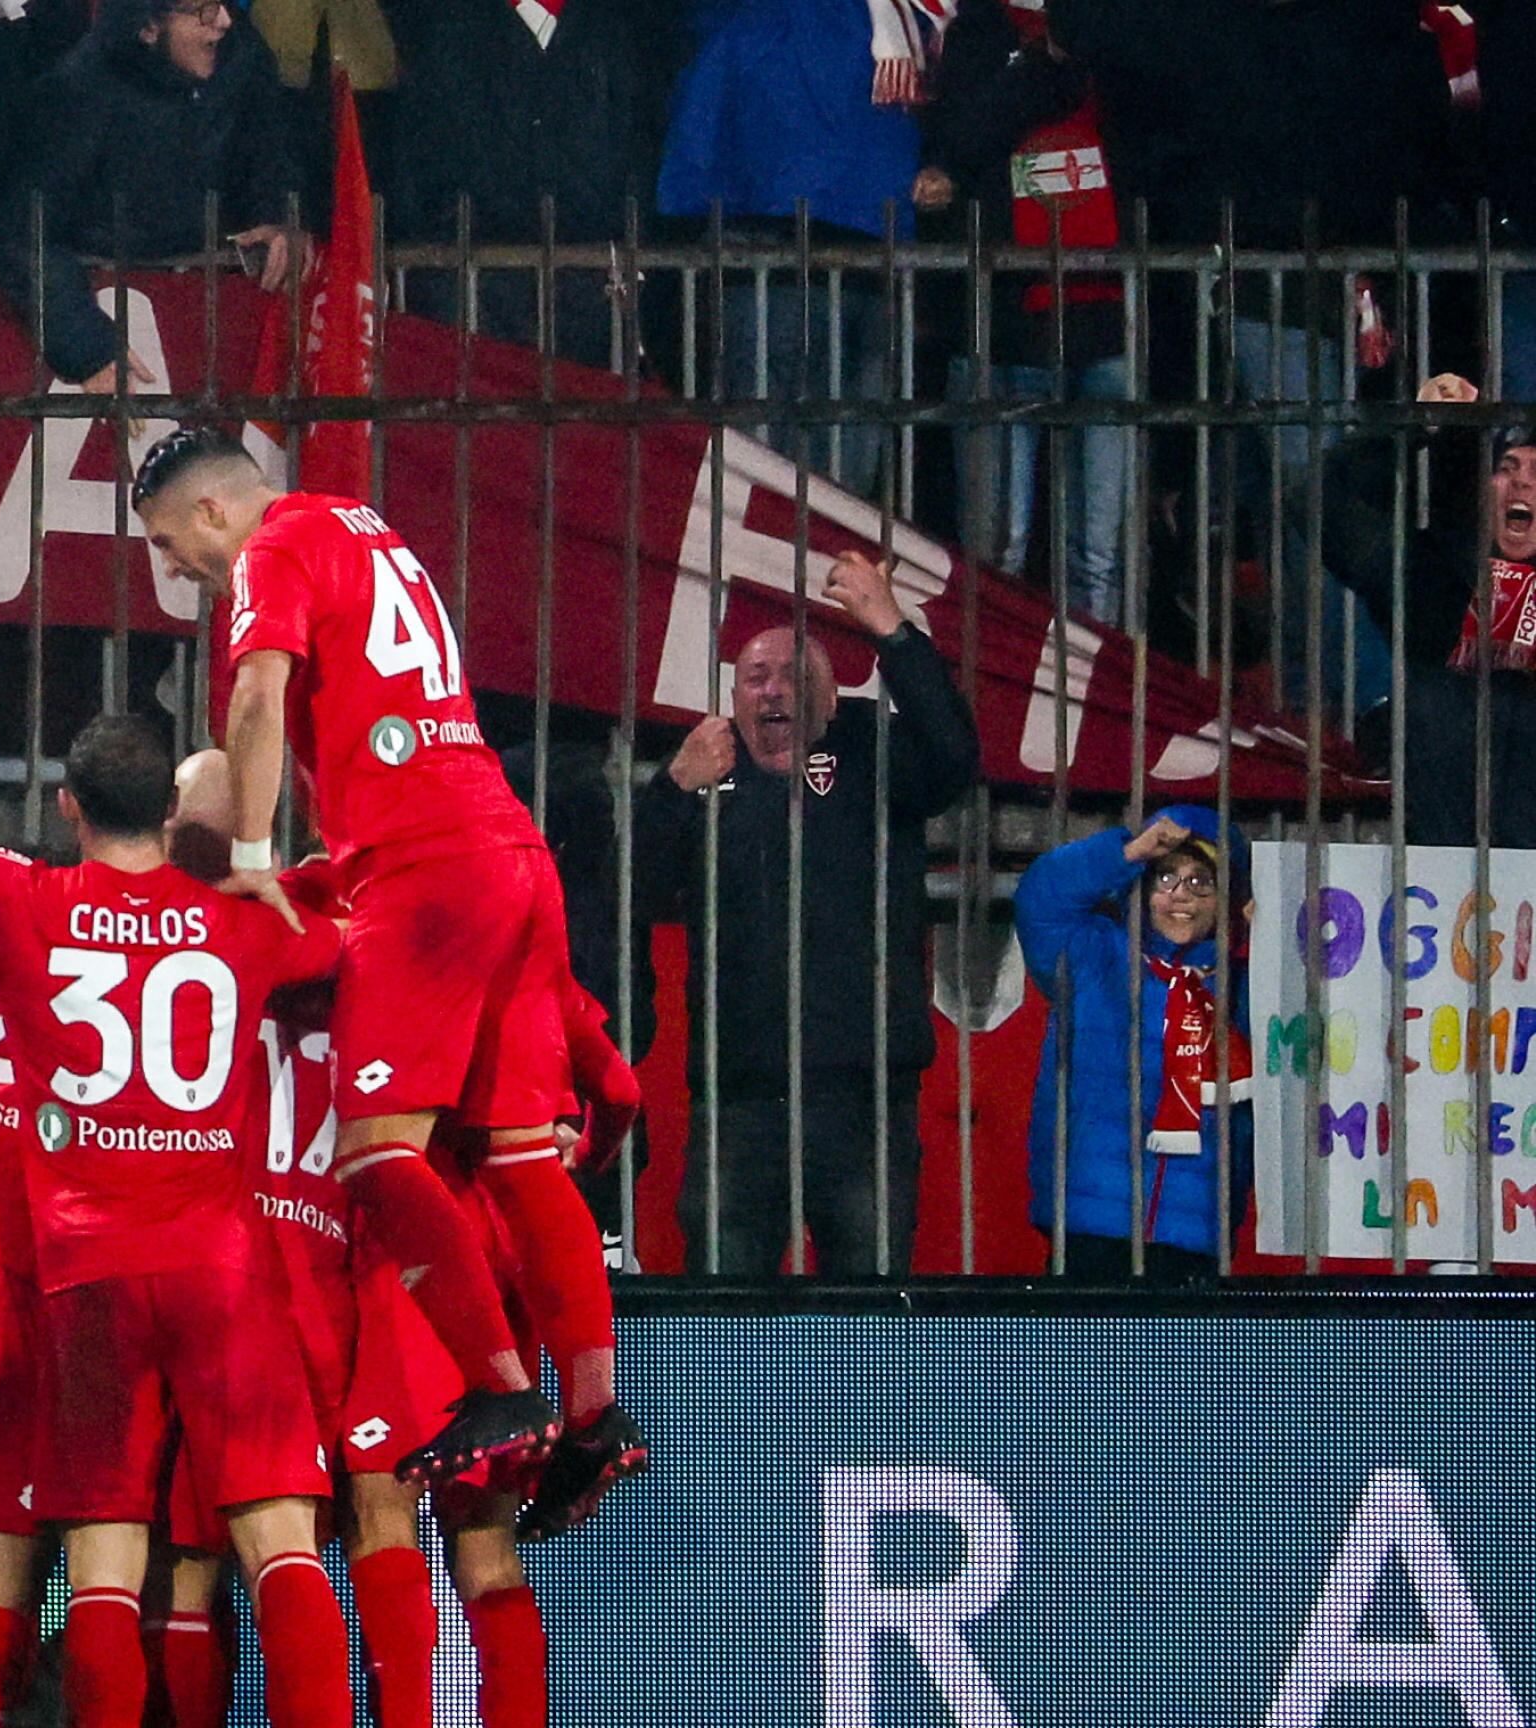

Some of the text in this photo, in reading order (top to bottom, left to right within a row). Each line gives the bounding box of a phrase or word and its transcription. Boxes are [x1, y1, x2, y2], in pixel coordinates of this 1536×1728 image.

[365, 546, 462, 702] 47
[69, 903, 209, 946] CARLOS
[1296, 886, 1535, 984] OGGI
[47, 946, 240, 1113] 30
[1265, 1009, 1358, 1078] MO
[77, 1115, 236, 1152] Pontenossa
[1317, 1100, 1391, 1160] MI
